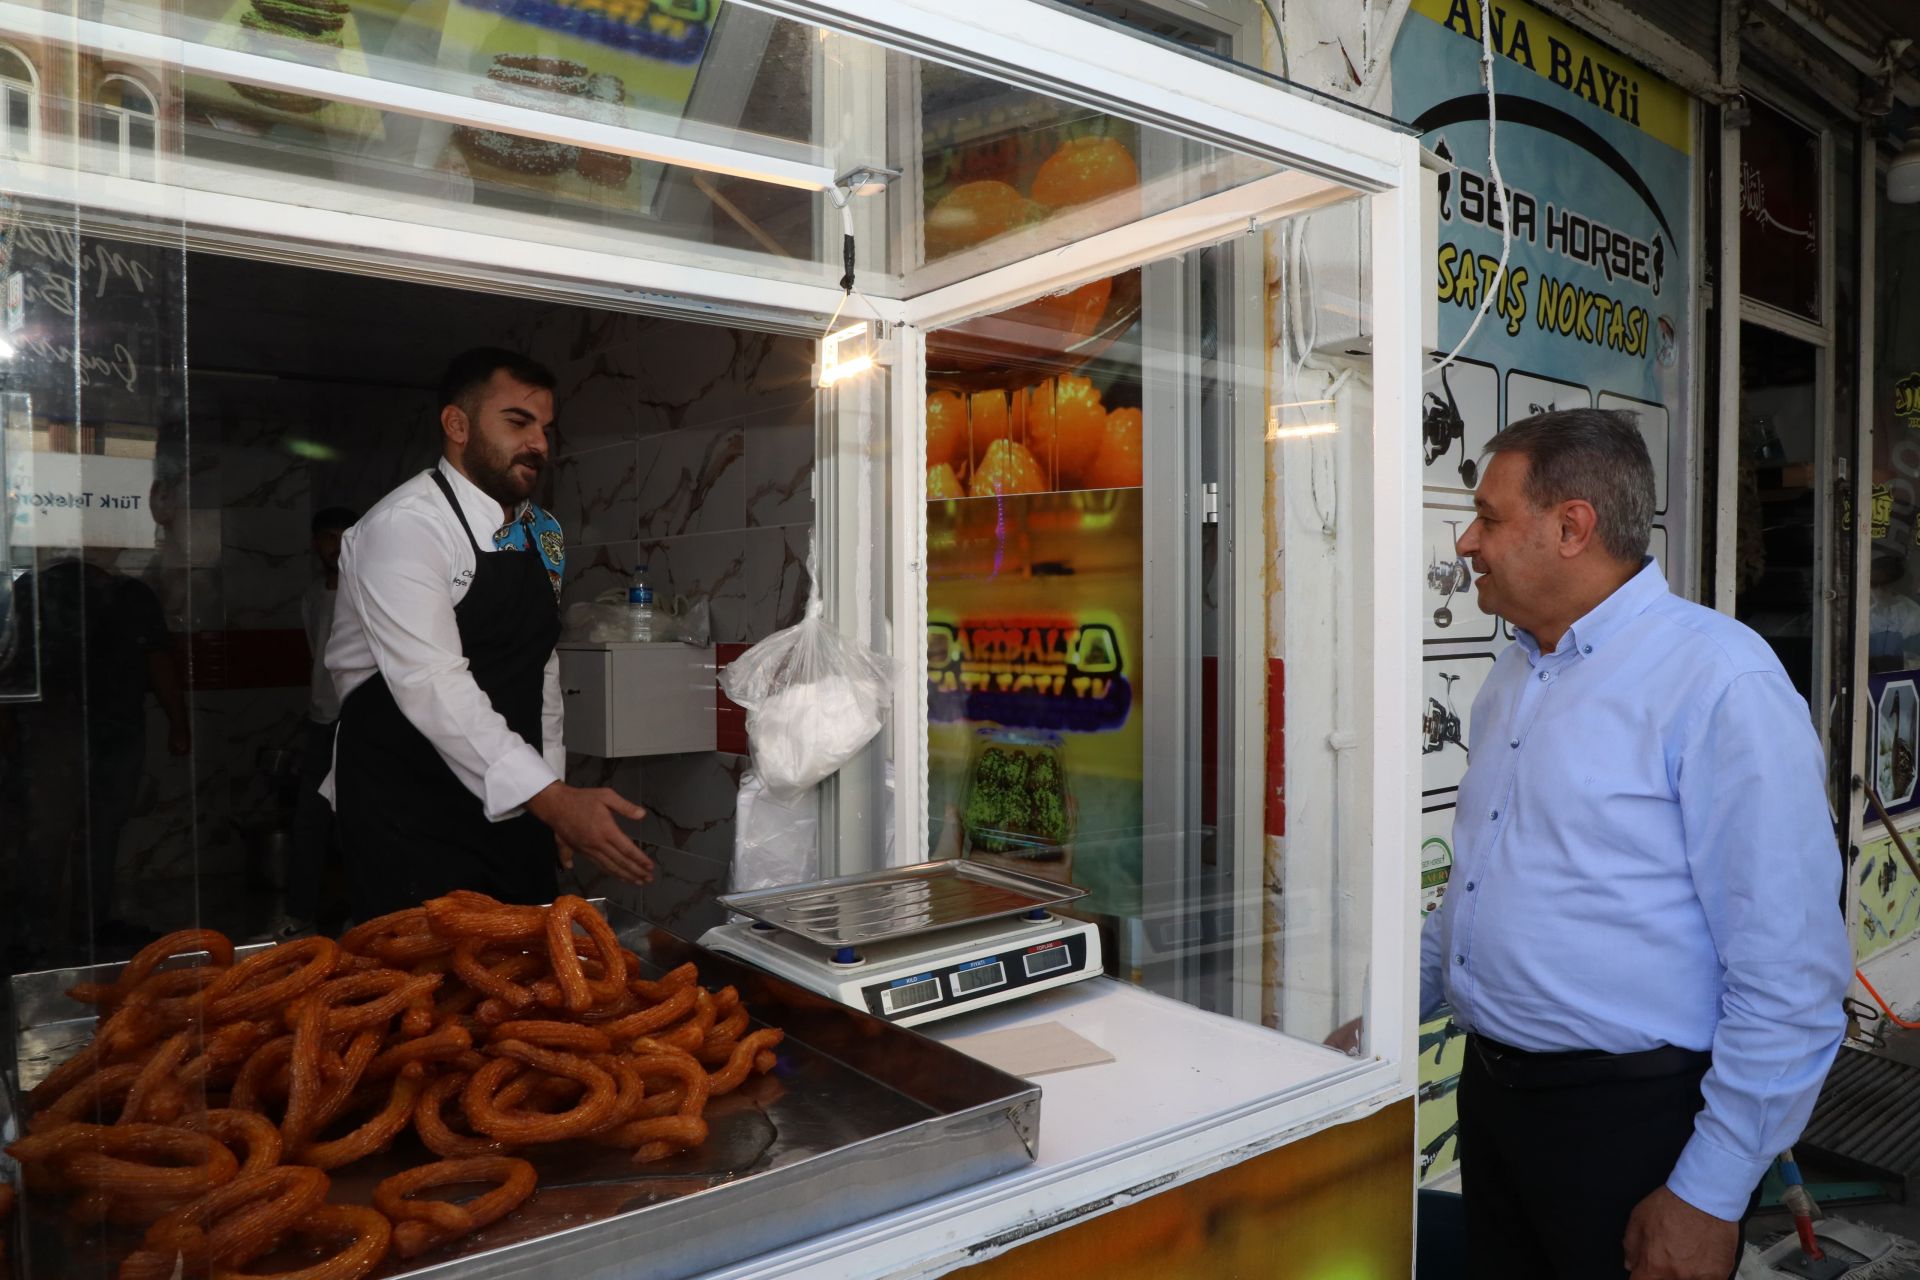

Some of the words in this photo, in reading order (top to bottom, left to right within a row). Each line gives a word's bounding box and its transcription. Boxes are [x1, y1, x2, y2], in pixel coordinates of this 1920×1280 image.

[1443, 0, 1537, 72] ANA
[1460, 171, 1535, 242] SEA
[1547, 207, 1649, 285] HORSE
[1438, 243, 1529, 336] SATIŞ
[1537, 275, 1649, 359] NOKTASI
